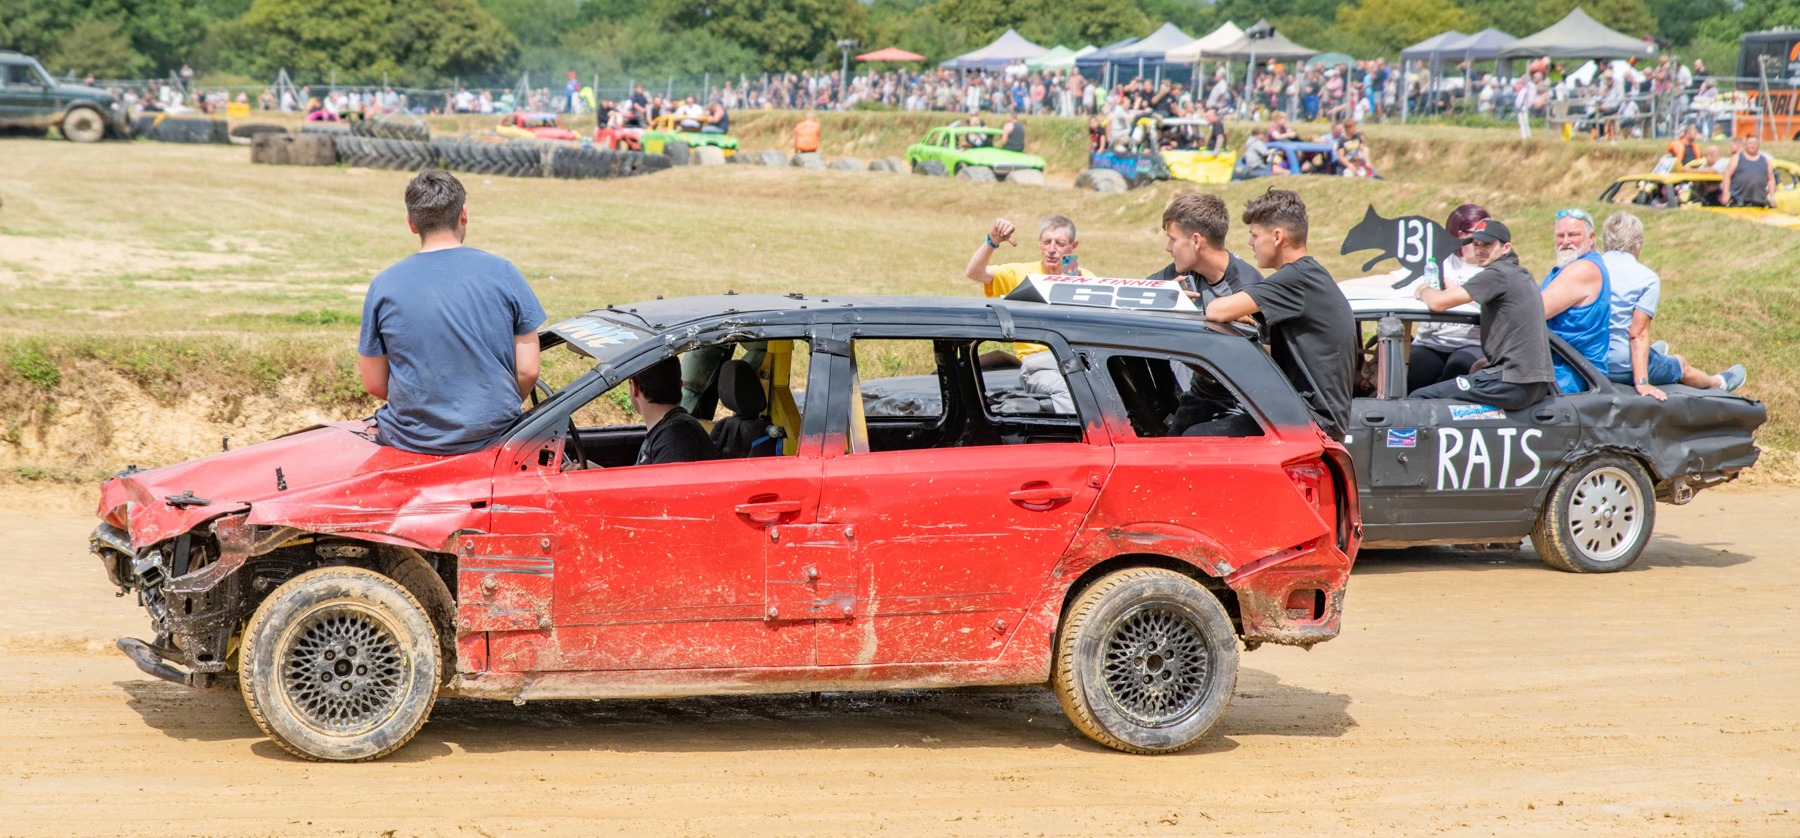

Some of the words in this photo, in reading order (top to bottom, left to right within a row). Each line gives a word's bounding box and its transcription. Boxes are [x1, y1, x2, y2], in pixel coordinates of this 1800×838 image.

[1397, 219, 1434, 264] 131
[1049, 283, 1180, 309] 69
[1098, 278, 1166, 287] FINNIE
[1437, 427, 1543, 490] RATS
